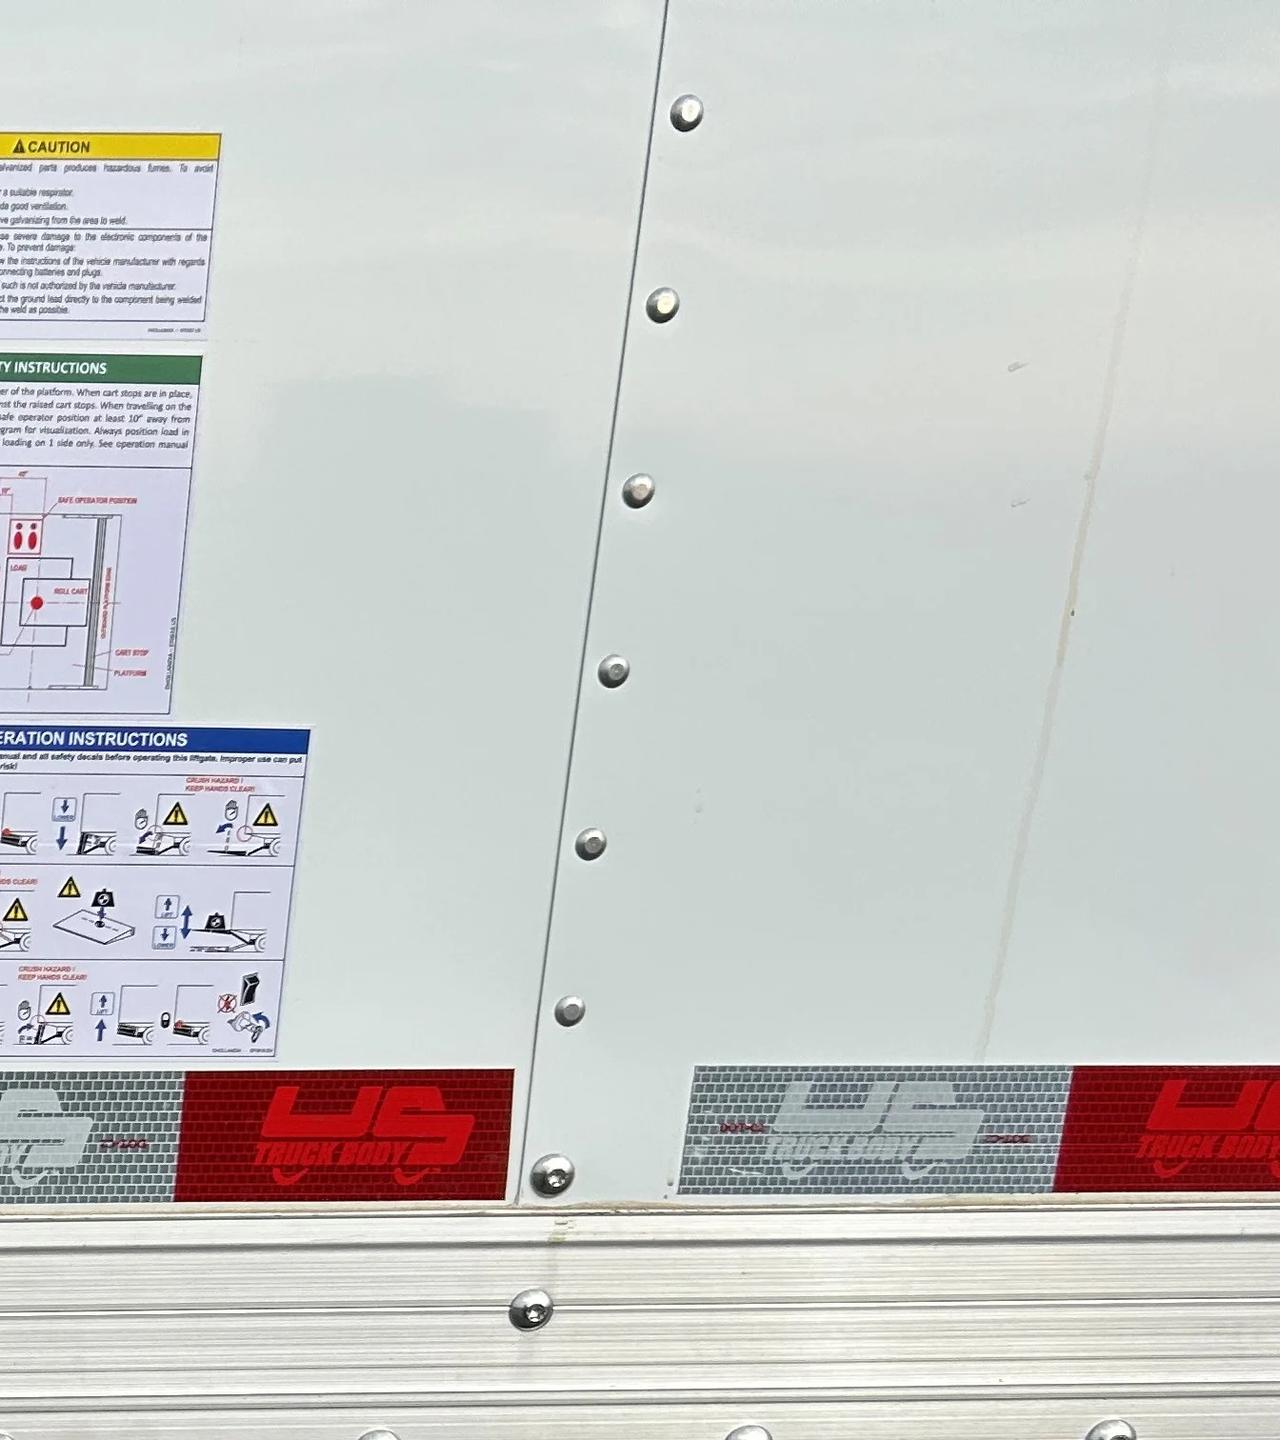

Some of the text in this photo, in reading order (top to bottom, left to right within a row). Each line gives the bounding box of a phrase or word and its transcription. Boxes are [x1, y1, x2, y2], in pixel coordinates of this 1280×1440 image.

[28, 140, 90, 153] CAUTION
[14, 361, 106, 374] INSTRUCTIONS
[69, 731, 187, 746] INSTRUCTIONS
[261, 1087, 475, 1165] US
[773, 1081, 985, 1159] US
[254, 1142, 411, 1165] TRUCK BODY
[762, 1136, 922, 1159] TRUCK BODY
[1136, 1135, 1223, 1158] TRUCK
